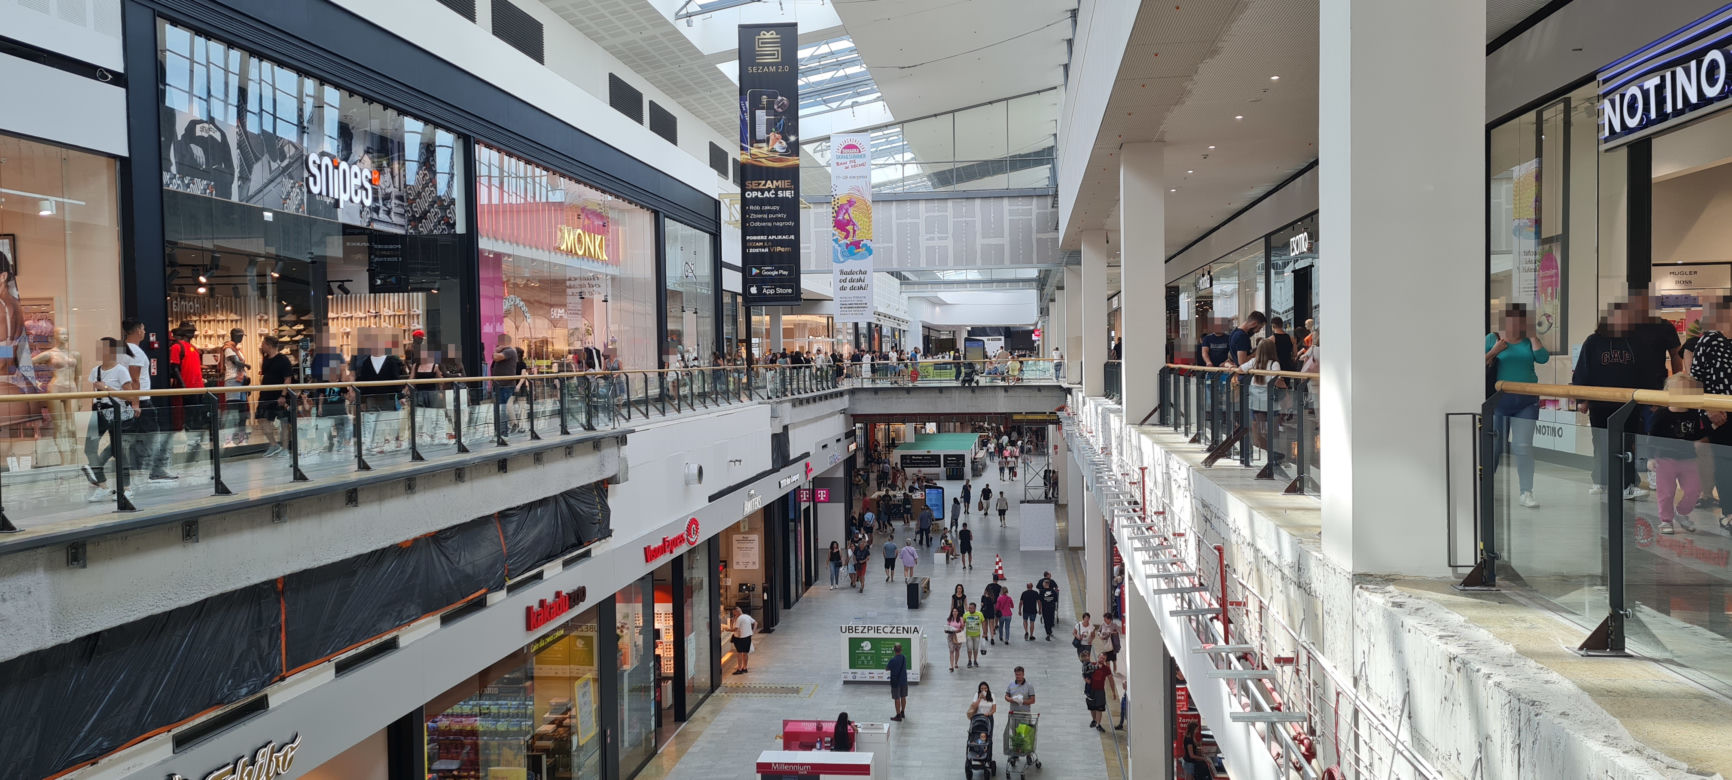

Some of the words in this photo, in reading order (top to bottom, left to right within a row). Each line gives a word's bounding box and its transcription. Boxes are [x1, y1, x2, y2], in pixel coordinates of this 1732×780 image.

[1603, 49, 1726, 137] NOTINO
[308, 152, 372, 209] snipes
[745, 180, 795, 189] SEZAMIE,
[412, 182, 437, 217] snipes
[745, 190, 776, 198] OPŁAĆ
[777, 190, 795, 199] SIĘ!
[560, 228, 609, 261] MONKI
[1289, 231, 1309, 256] ESOTIQ
[839, 268, 868, 276] Radocha
[762, 287, 776, 295] App
[1536, 424, 1564, 438] NOTINO
[840, 625, 920, 635] UBEZPIECZENIA
[771, 762, 812, 771] Millennium
